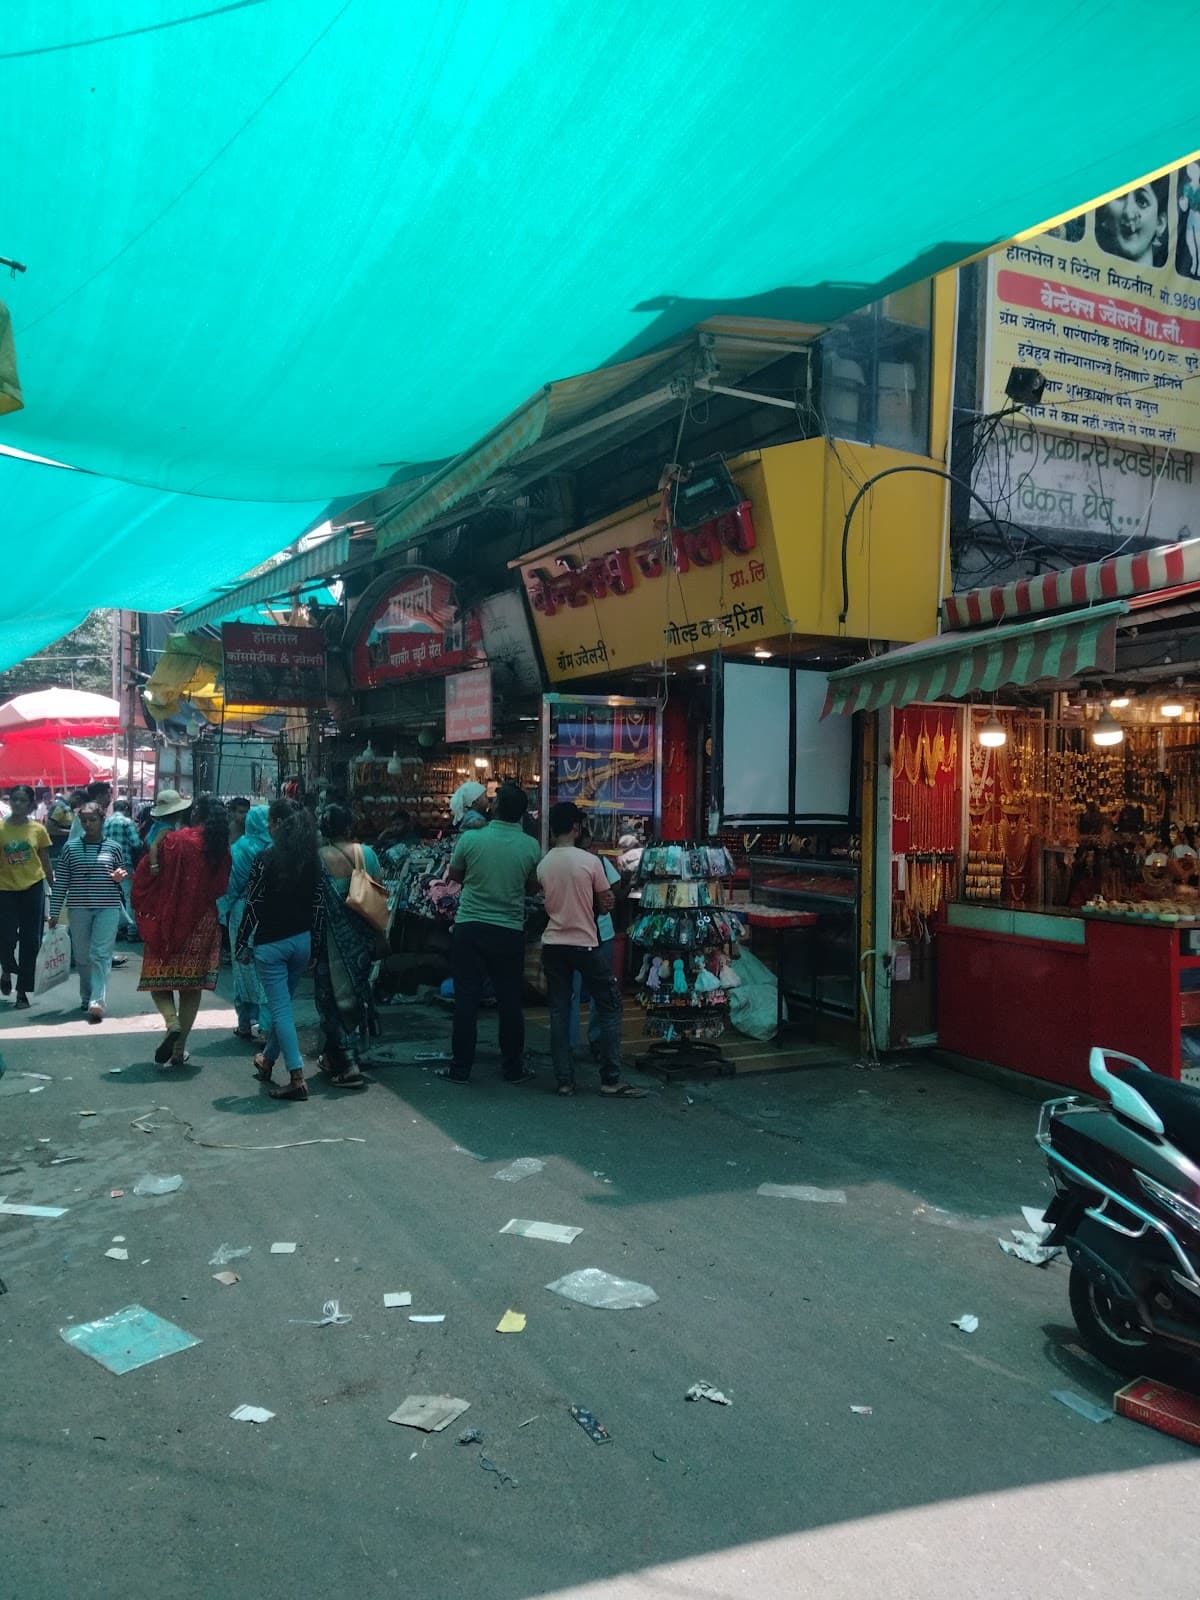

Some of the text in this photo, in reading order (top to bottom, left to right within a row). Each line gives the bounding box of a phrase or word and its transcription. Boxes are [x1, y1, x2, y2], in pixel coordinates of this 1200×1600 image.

[1058, 257, 1066, 272] व
[1071, 256, 1100, 281] रिटेल
[1099, 300, 1142, 333] ज्वेलरी
[280, 651, 290, 664] &
[574, 639, 609, 666] ज्वेलरी
